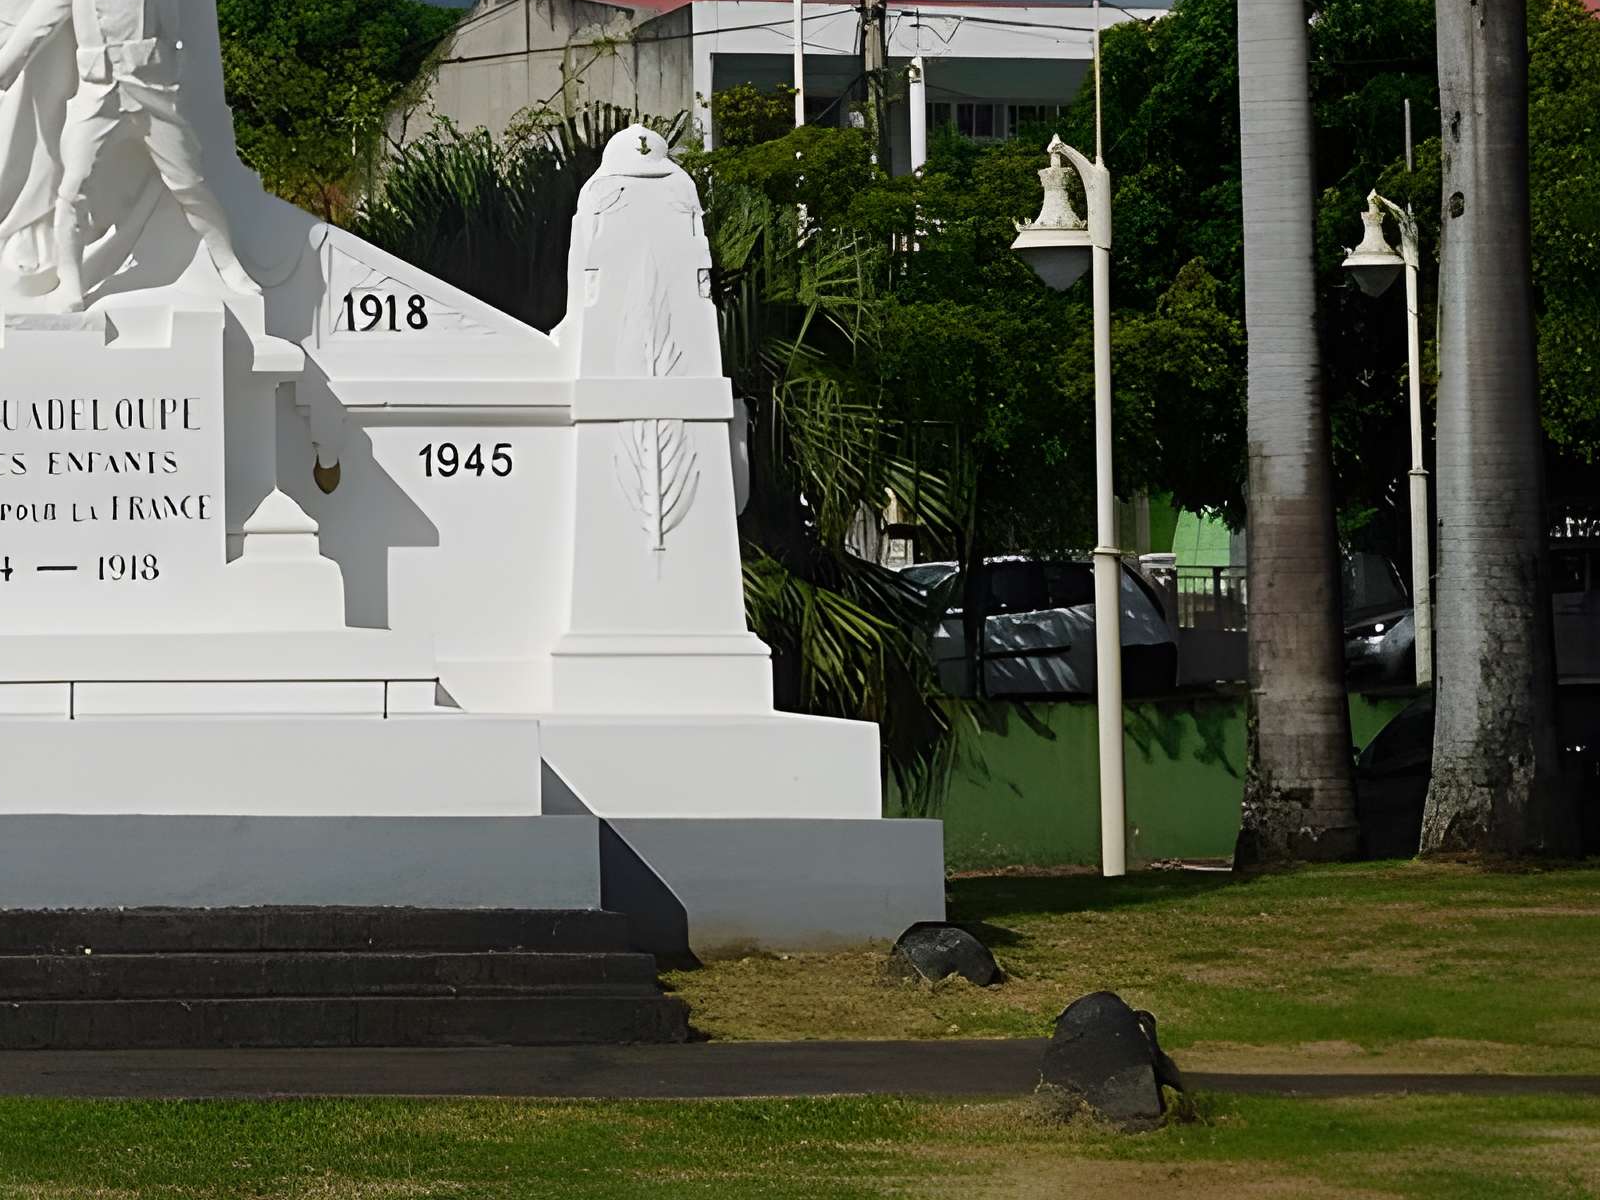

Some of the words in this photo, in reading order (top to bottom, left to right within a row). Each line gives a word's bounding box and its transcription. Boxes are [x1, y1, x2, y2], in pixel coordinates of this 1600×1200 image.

[343, 291, 429, 332] 1918
[48, 451, 177, 475] ENFANTS
[419, 442, 513, 477] 1945
[112, 494, 212, 521] FRANCE
[98, 553, 159, 581] 1918
